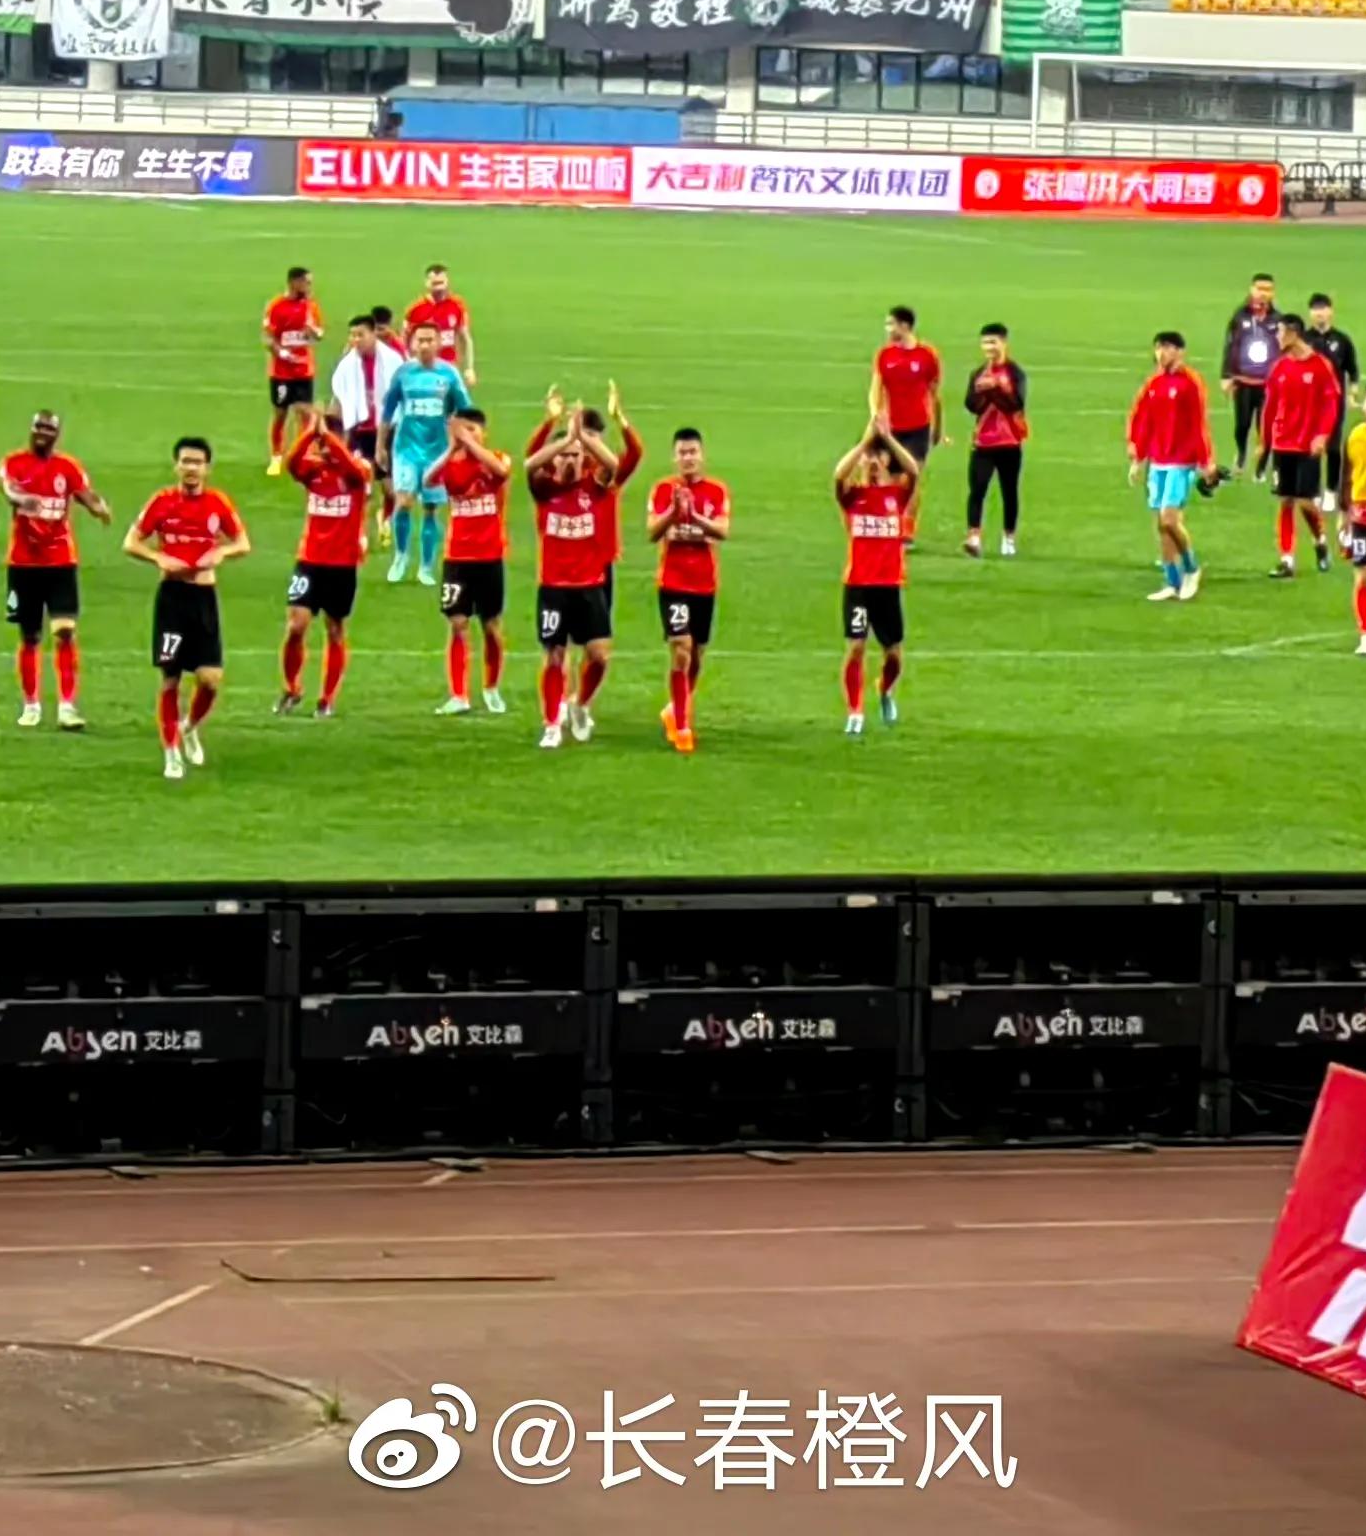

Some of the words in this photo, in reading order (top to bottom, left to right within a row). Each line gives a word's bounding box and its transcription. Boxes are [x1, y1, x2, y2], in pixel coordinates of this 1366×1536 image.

[1, 145, 125, 179] 联赛有你
[133, 148, 253, 181] 生生不息
[305, 148, 450, 188] ELIVIN
[459, 154, 627, 194] 生活家地板
